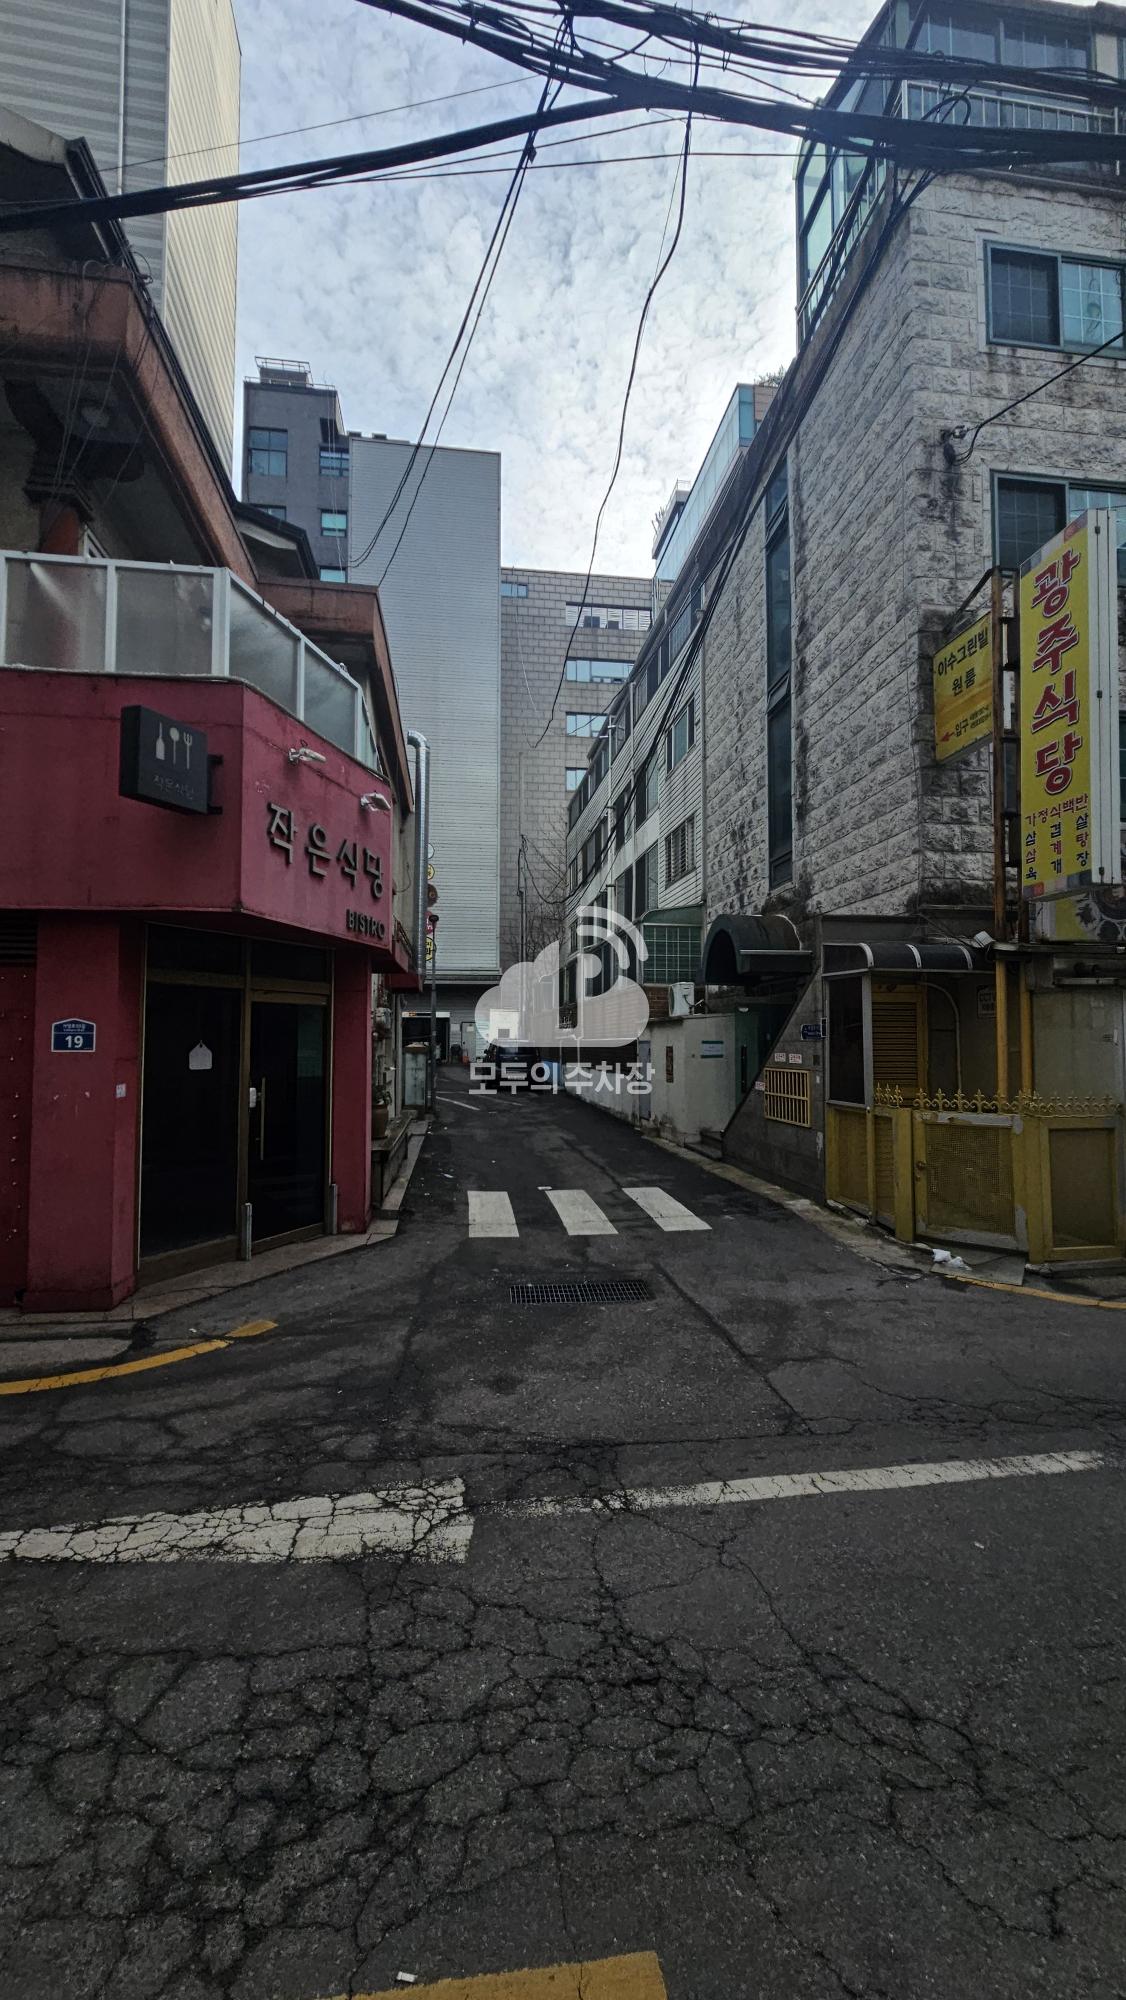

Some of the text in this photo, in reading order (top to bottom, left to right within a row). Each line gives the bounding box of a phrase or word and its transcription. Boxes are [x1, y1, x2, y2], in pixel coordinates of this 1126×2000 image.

[938, 627, 989, 676] 이수그린빌
[1032, 547, 1082, 795] 광주식당
[955, 718, 969, 737] 입구
[1025, 793, 1089, 828] 가정식백반
[268, 802, 384, 899] 작은식당
[346, 908, 386, 941] BISTRO
[65, 1035, 84, 1049] 19
